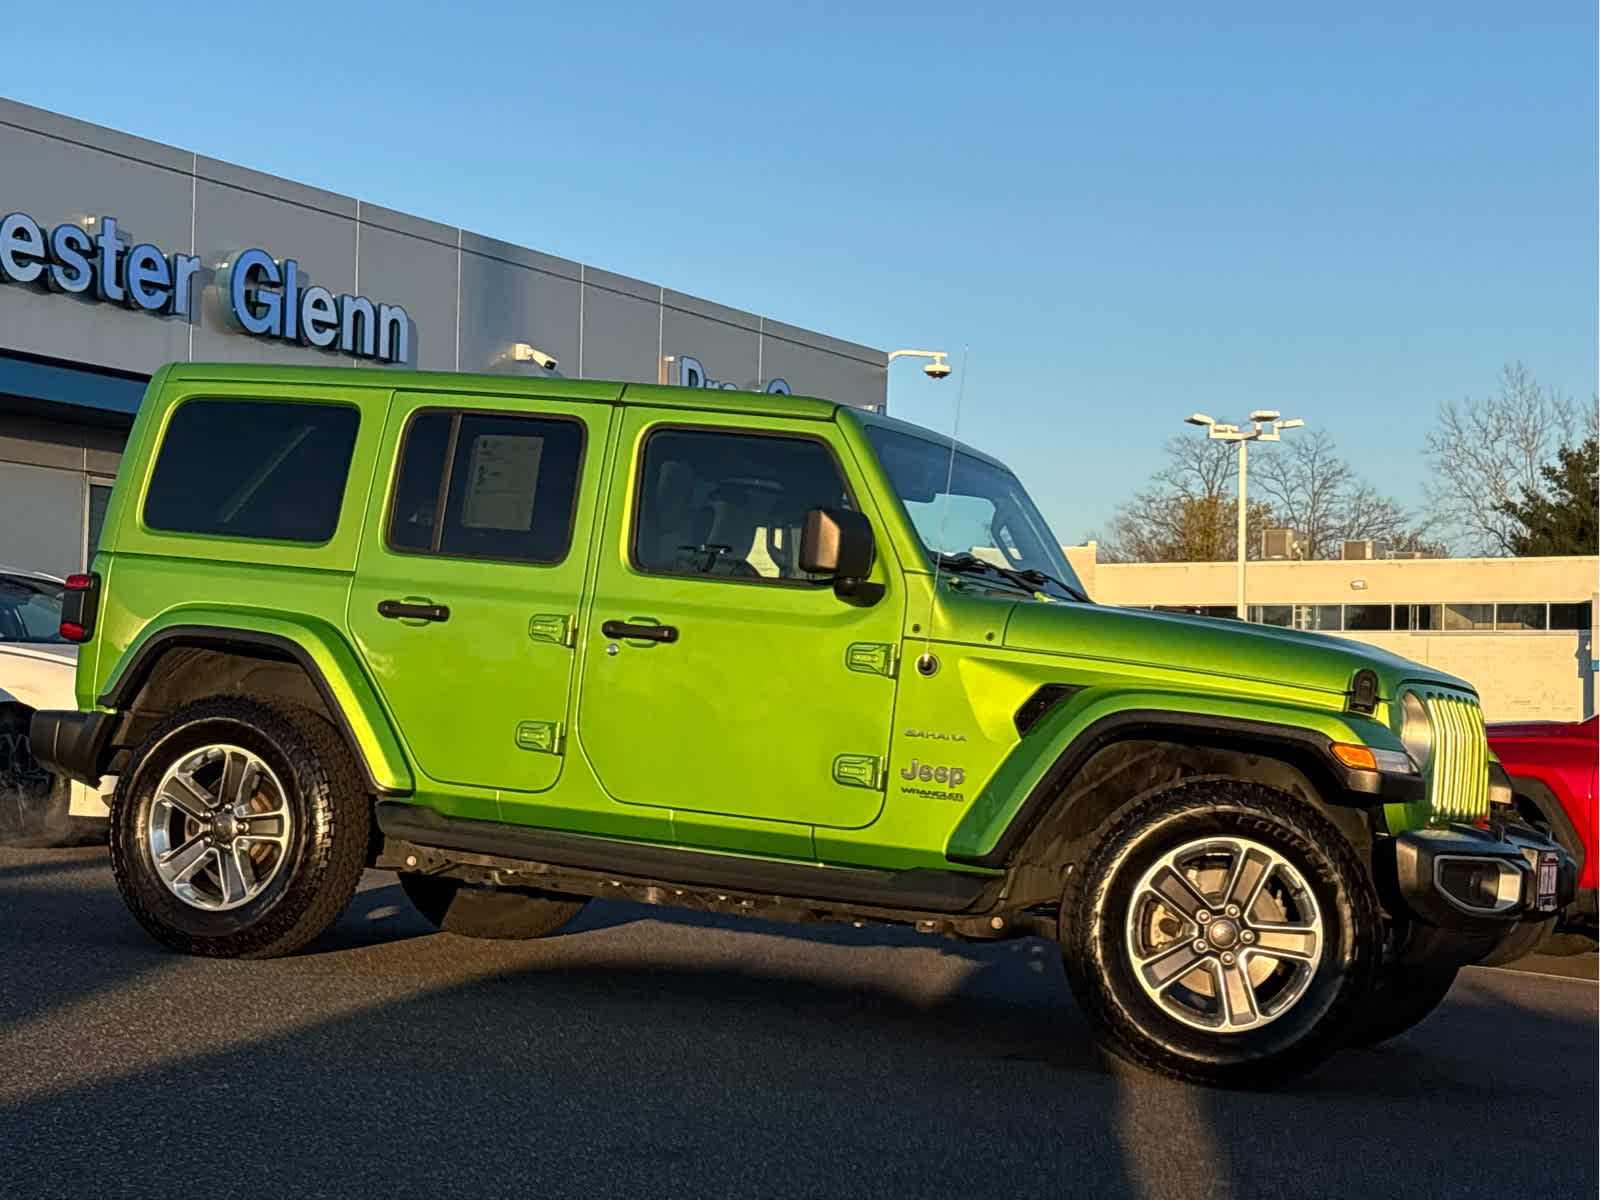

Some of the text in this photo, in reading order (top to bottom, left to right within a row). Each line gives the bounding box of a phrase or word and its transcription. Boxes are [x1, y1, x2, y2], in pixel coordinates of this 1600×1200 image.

[0, 212, 409, 363] ester Glenn
[904, 728, 967, 741] SAHARA
[901, 758, 965, 788] Jeep
[901, 786, 964, 799] WRANGLER
